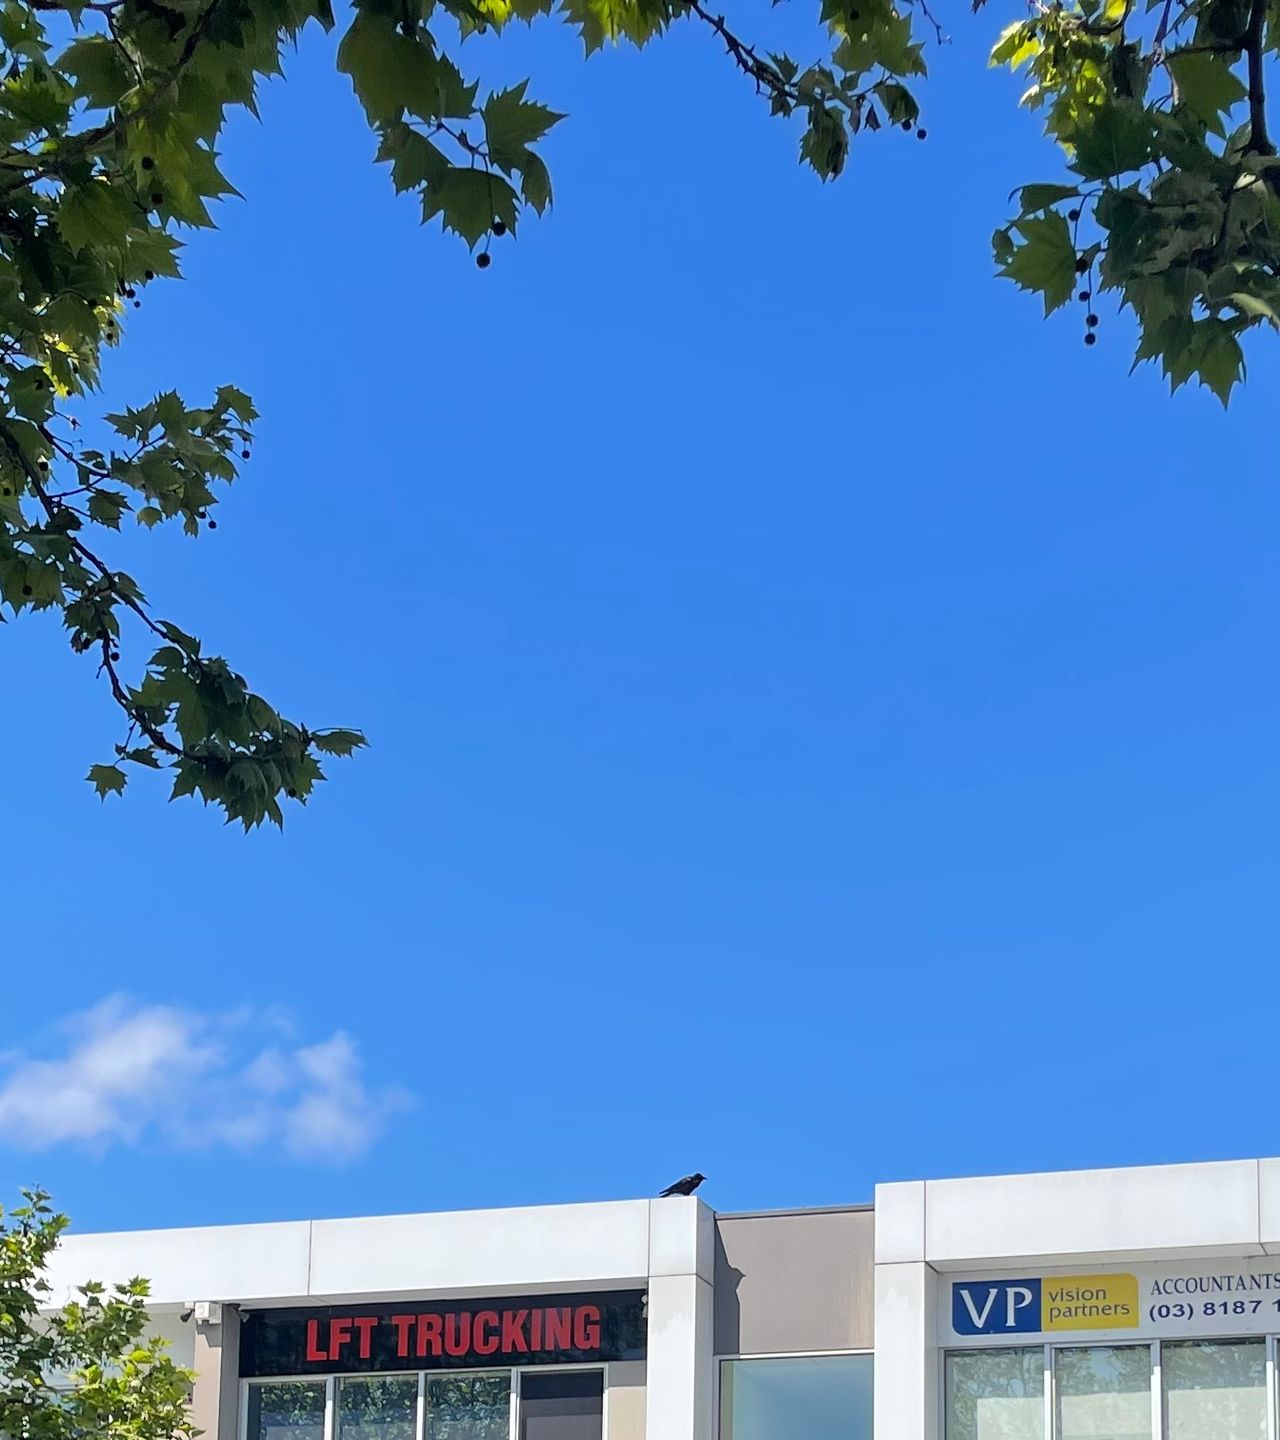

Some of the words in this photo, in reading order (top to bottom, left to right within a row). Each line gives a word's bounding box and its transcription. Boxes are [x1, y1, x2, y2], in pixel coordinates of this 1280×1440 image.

[1048, 1287, 1107, 1302] vision
[959, 1286, 1033, 1329] VP
[1049, 1302, 1131, 1323] partners
[1149, 1303, 1194, 1323] (03)
[1202, 1300, 1263, 1317] 8187
[306, 1317, 379, 1361] LFT
[391, 1305, 601, 1357] TRUCKING
